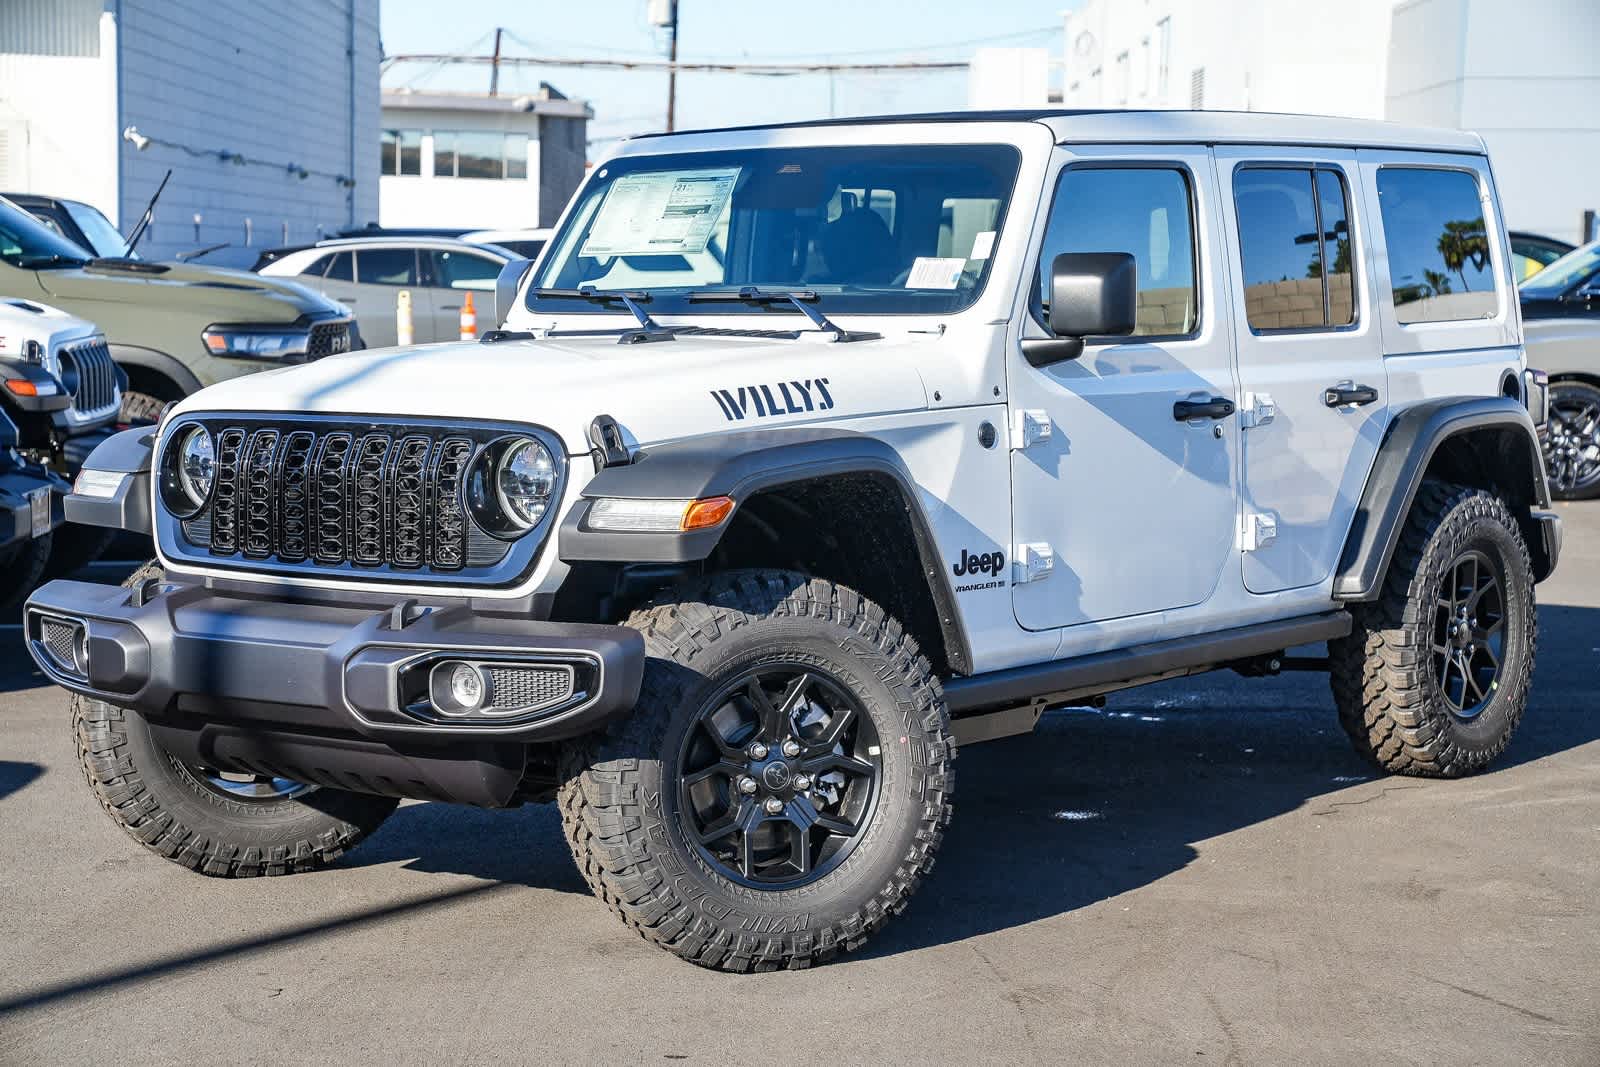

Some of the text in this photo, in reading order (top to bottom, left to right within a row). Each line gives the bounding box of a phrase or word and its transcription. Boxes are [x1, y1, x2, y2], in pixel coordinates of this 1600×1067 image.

[710, 377, 834, 420] WILLYS
[953, 549, 1005, 577] Jeep
[954, 581, 997, 593] WRANGLER
[641, 786, 811, 934] WILDPEAK
